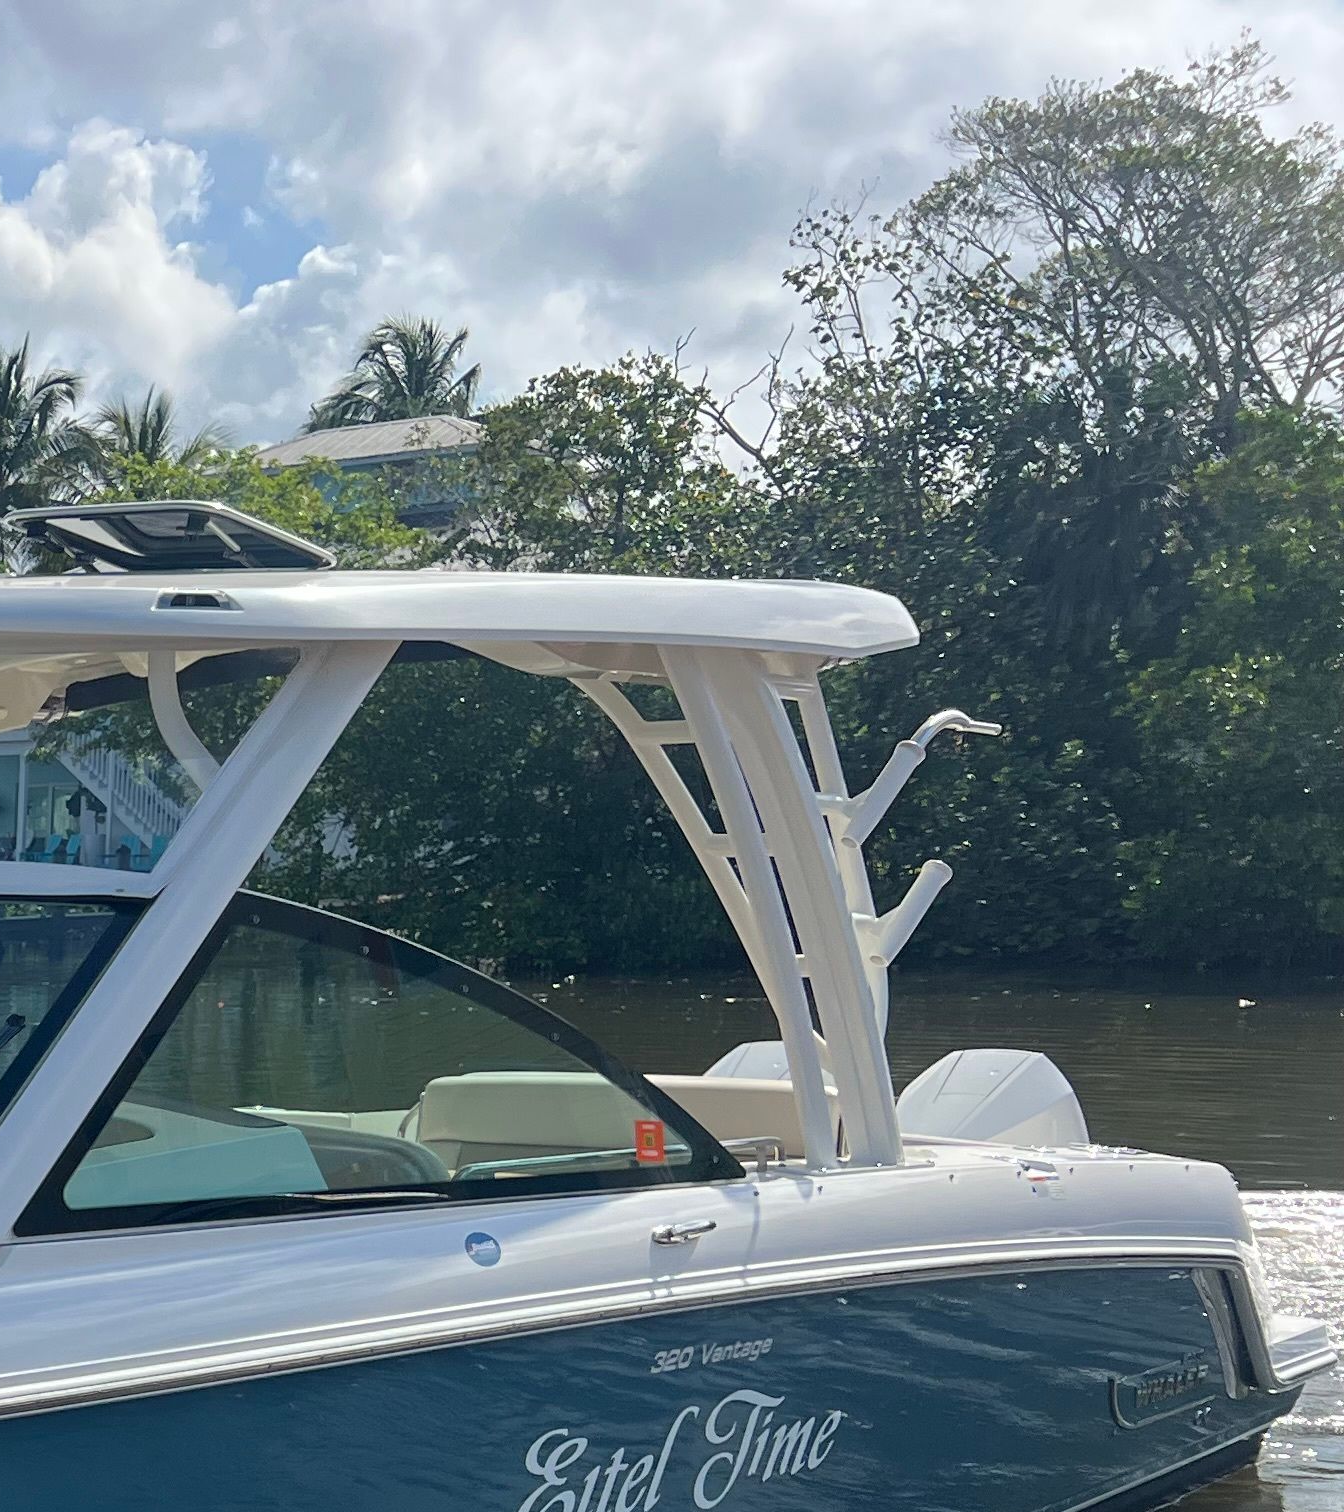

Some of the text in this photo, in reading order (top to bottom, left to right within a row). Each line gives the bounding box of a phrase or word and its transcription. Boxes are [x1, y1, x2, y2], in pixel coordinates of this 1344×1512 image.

[650, 1337, 774, 1374] 320 Vantage
[693, 1388, 842, 1510] Time
